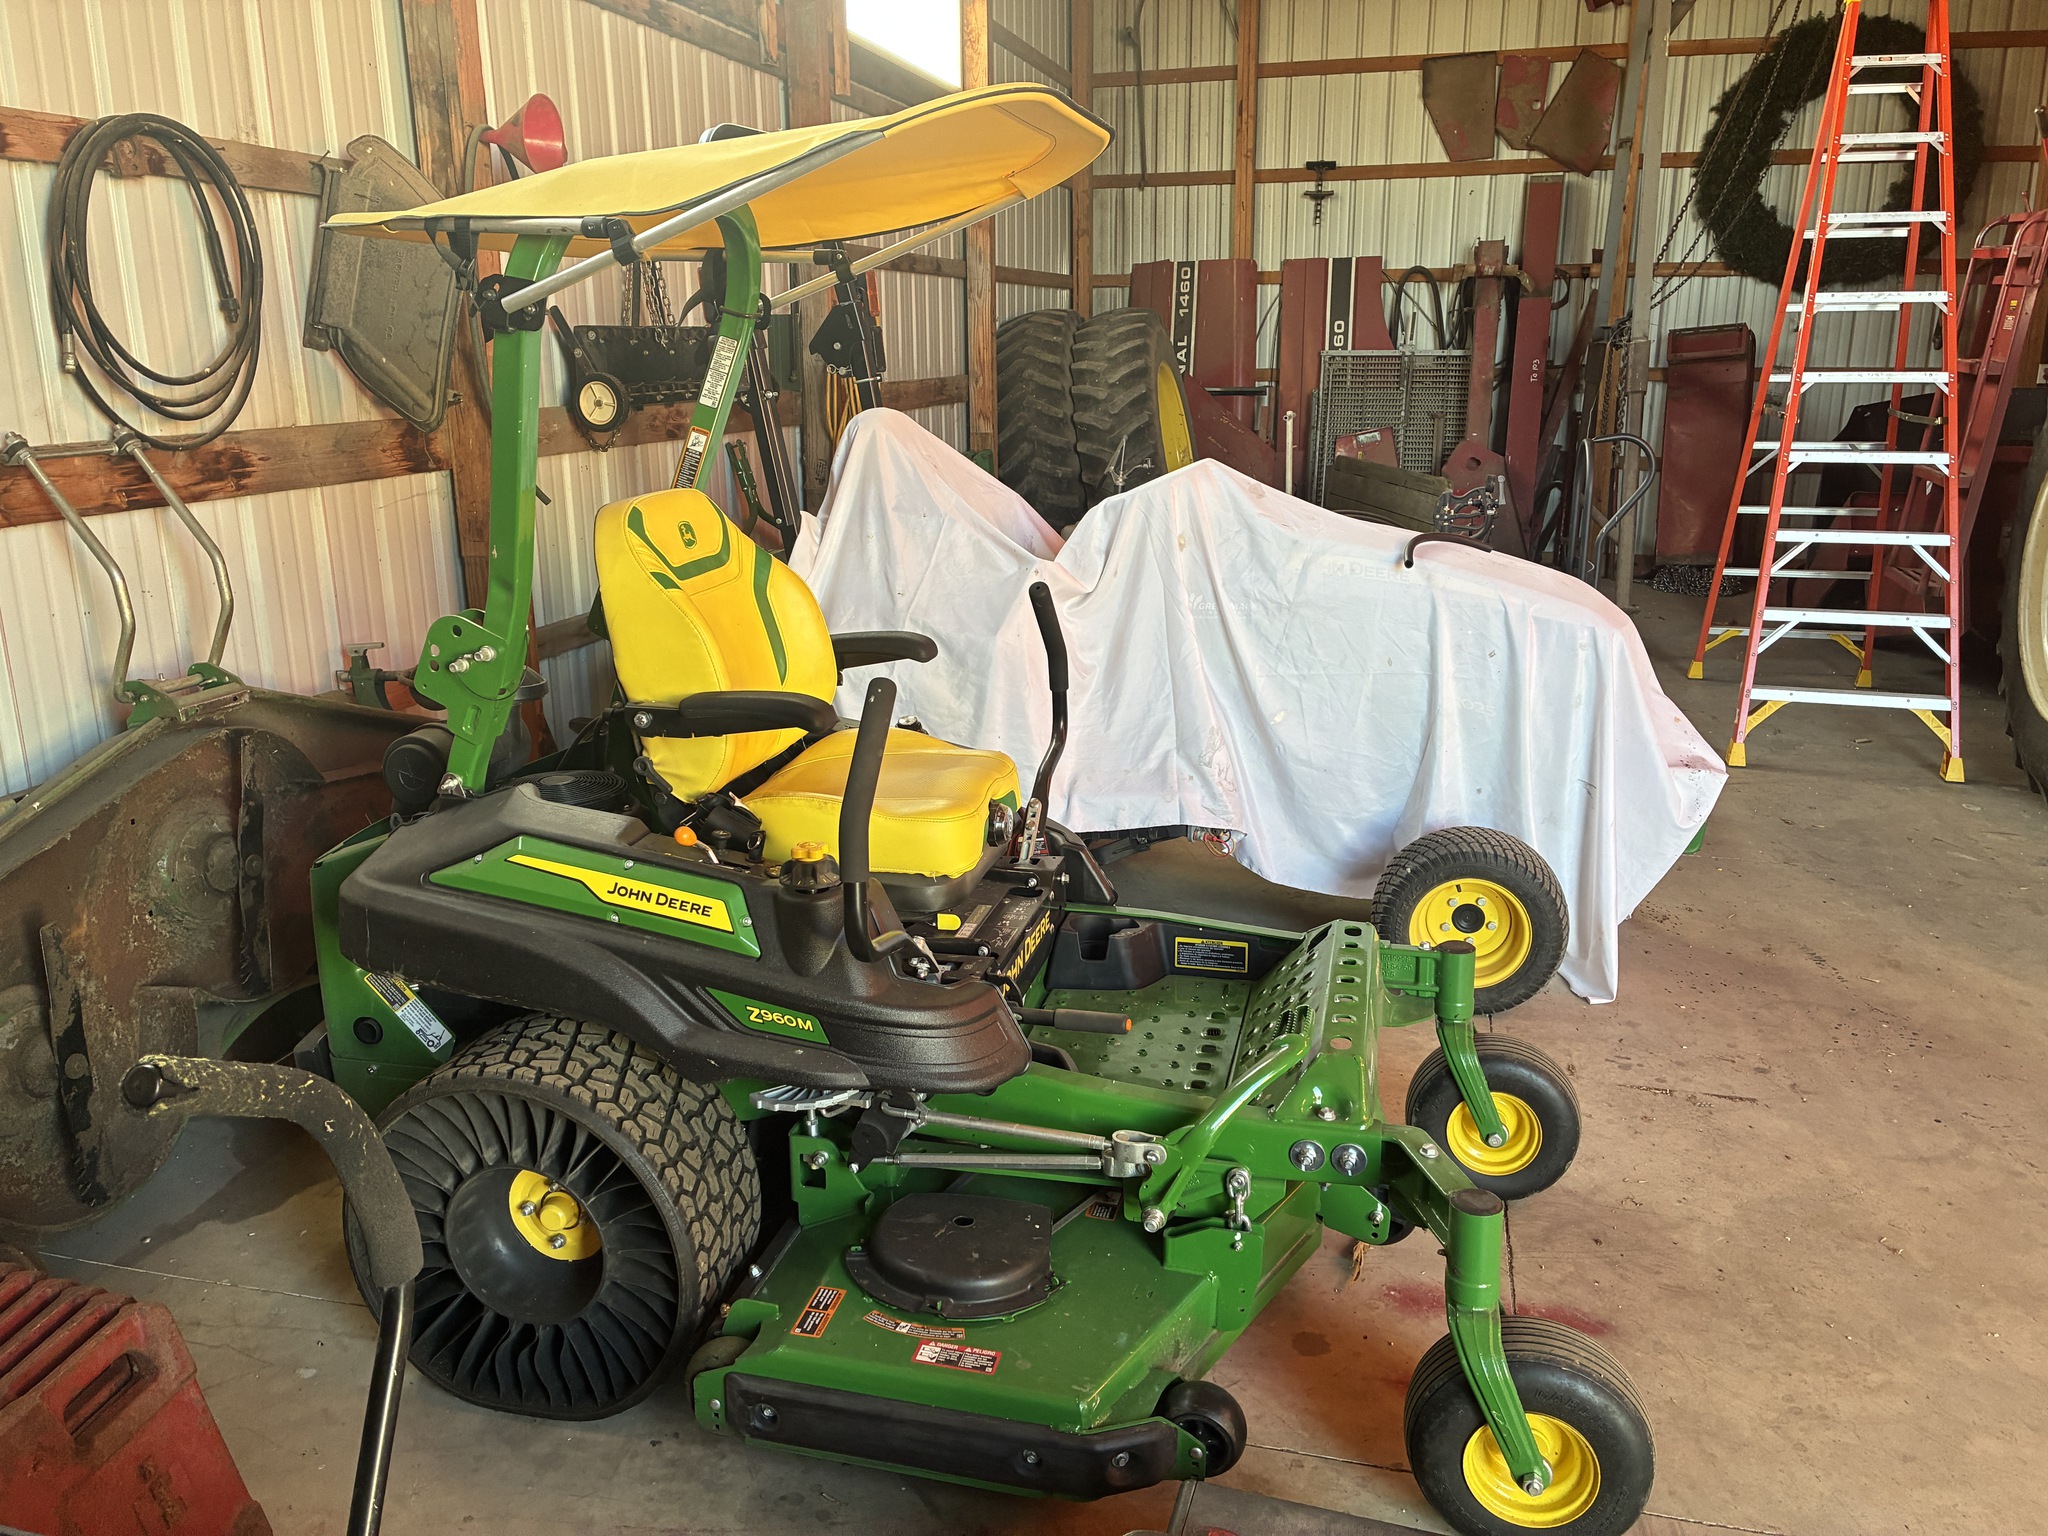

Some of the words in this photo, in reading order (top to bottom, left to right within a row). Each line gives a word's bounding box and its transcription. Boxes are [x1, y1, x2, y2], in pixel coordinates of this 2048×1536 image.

[1179, 266, 1191, 317] 1460
[1333, 320, 1345, 350] 60
[606, 881, 654, 905] JOHN
[655, 892, 713, 918] DEERE
[1024, 909, 1051, 963] DEERE
[745, 1005, 814, 1033] Z960M
[937, 1342, 959, 1350] DANGER
[973, 1348, 996, 1356] PELIGRO
